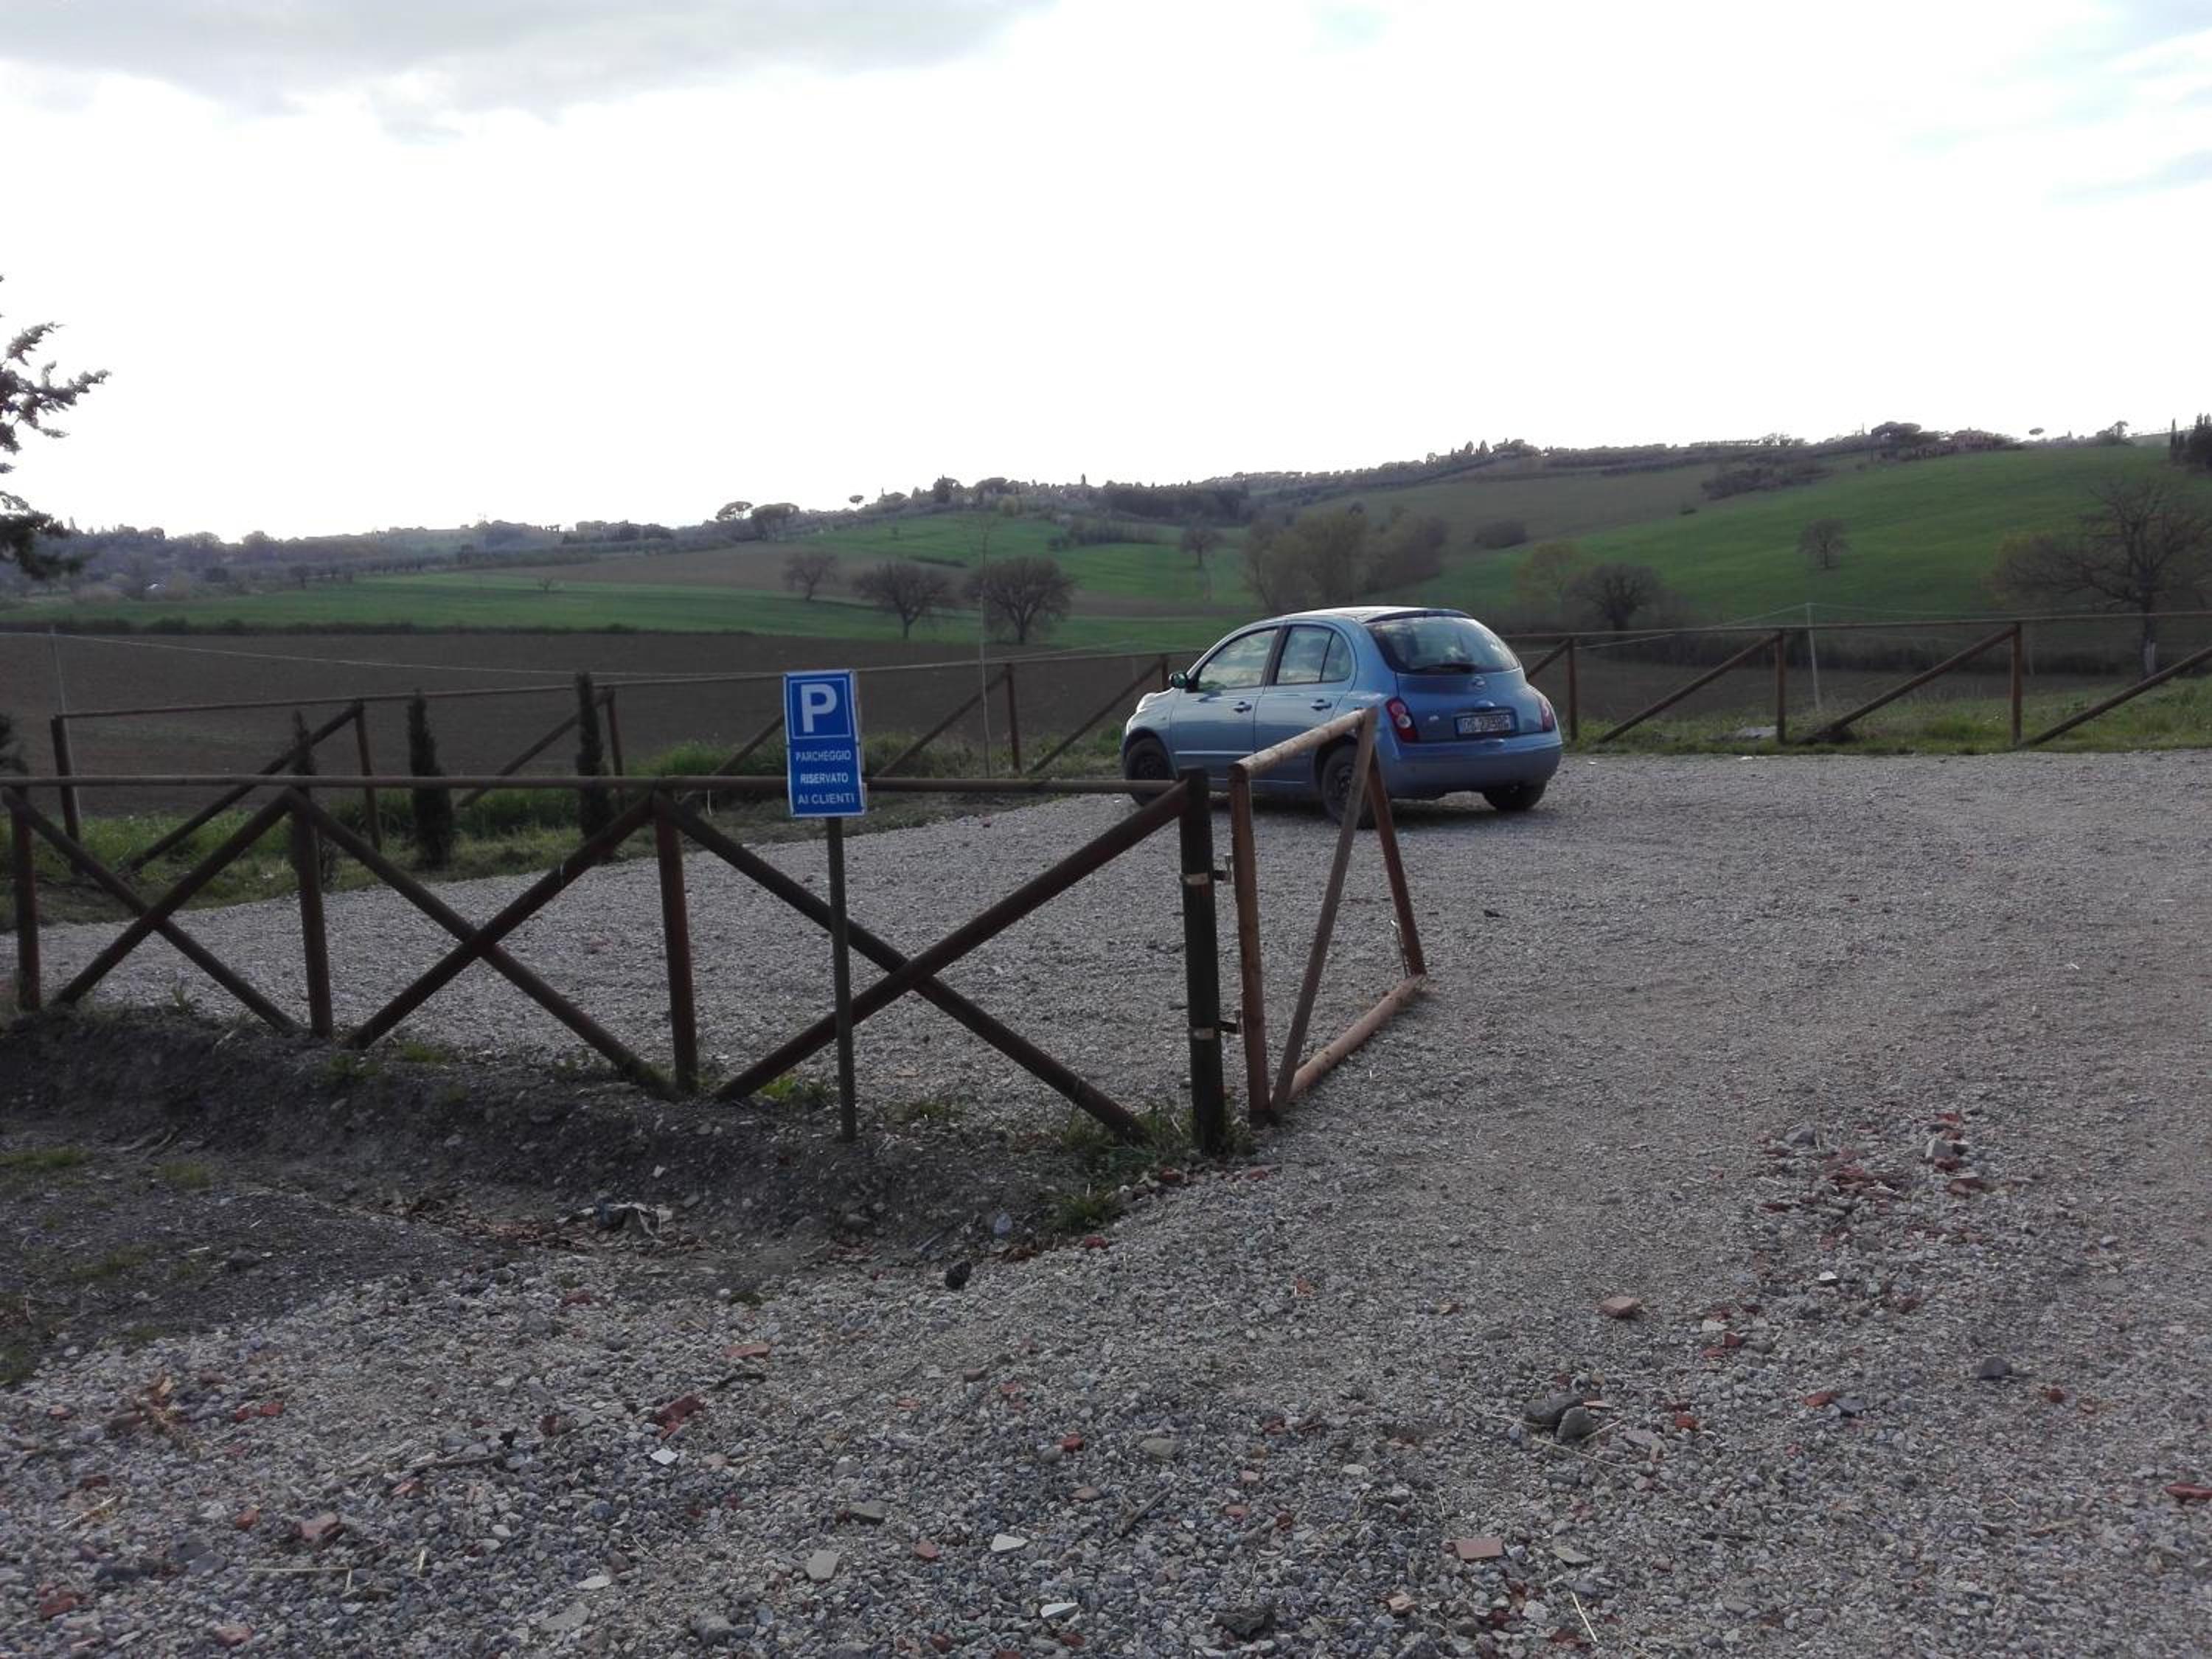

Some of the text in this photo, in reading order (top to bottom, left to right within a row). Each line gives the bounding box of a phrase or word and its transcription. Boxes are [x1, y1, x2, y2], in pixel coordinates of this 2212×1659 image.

[801, 684, 838, 733] P
[796, 750, 852, 762] PARCHEGGIO
[800, 773, 848, 784] RISERVATO
[797, 792, 855, 804] AI CLIENTI
